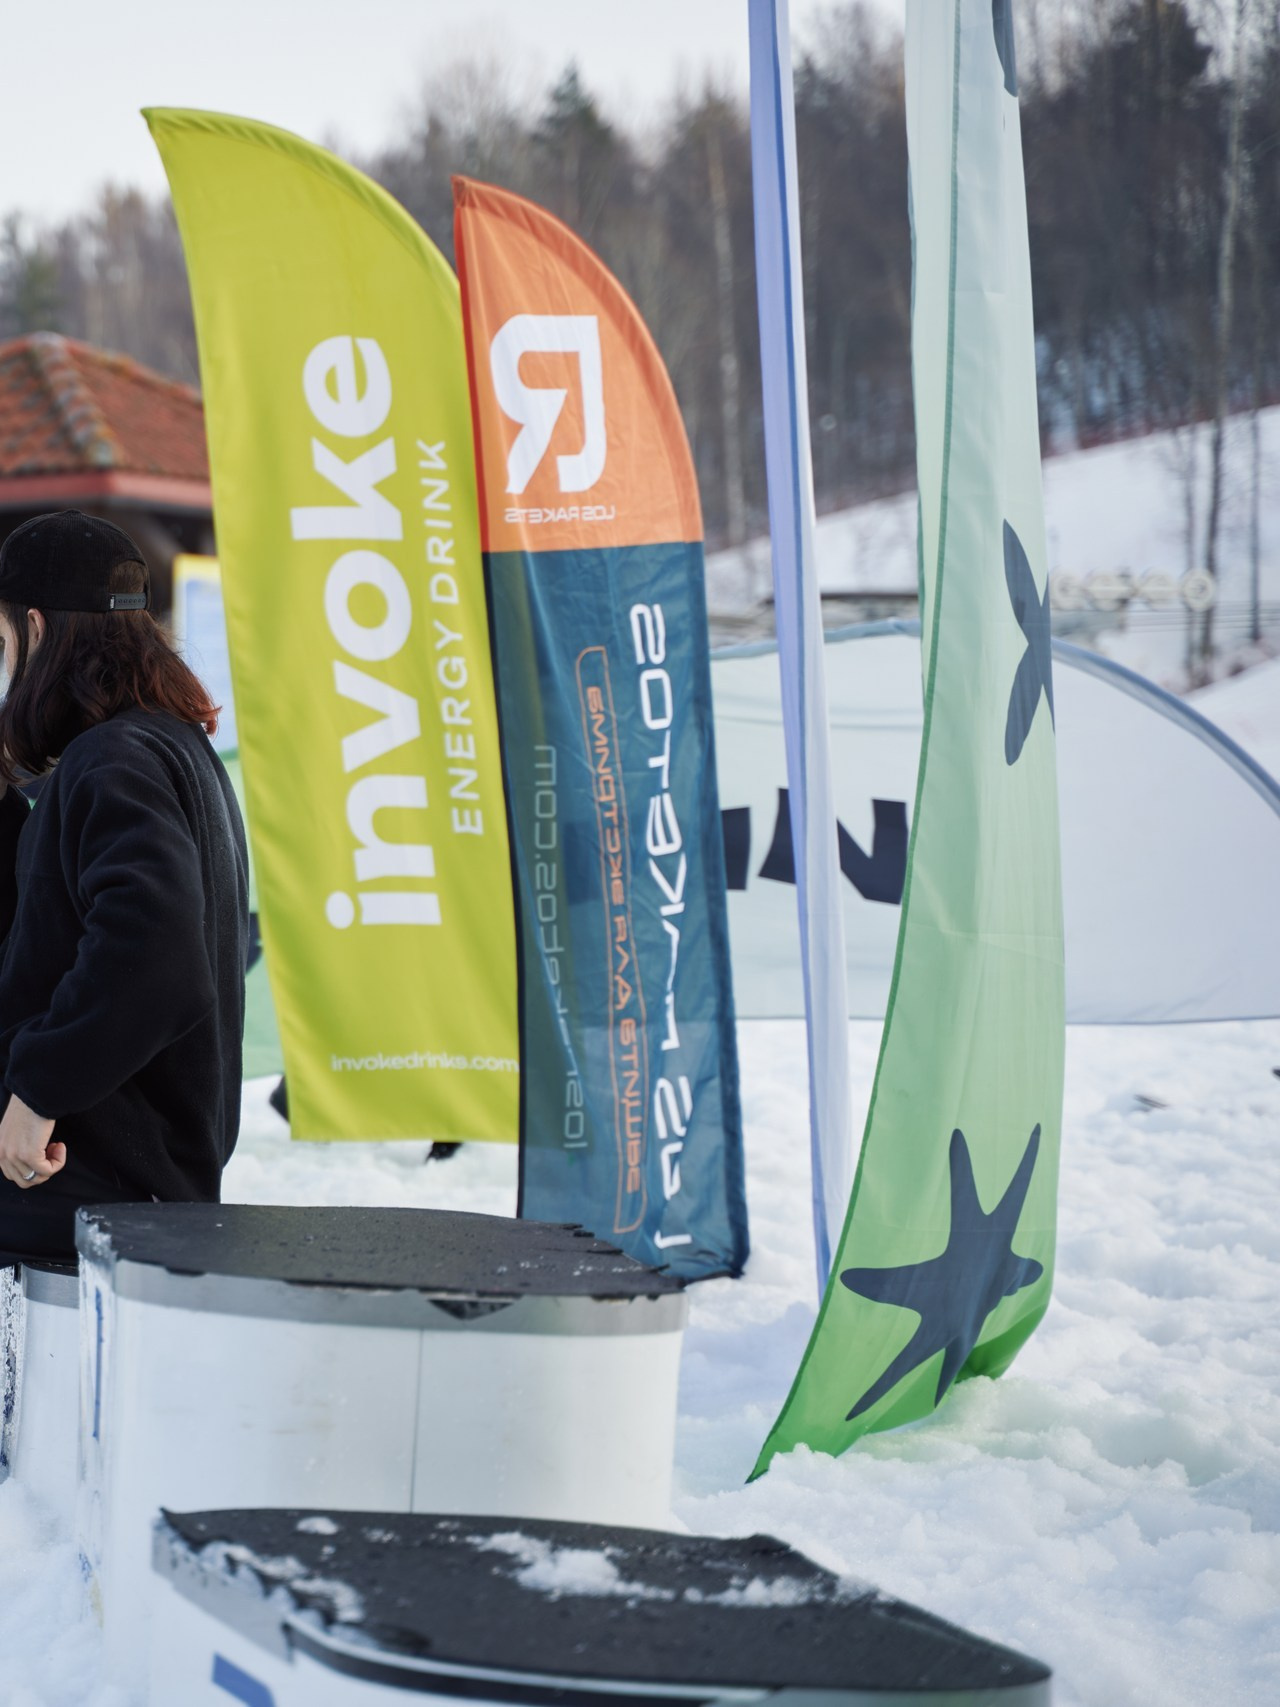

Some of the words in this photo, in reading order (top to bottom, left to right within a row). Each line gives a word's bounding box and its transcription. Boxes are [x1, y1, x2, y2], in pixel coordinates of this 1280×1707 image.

[416, 440, 460, 605] DRINK
[290, 335, 442, 928] invoke
[434, 620, 485, 835] ENERGY
[331, 1051, 519, 1073] invokedrinks.com
